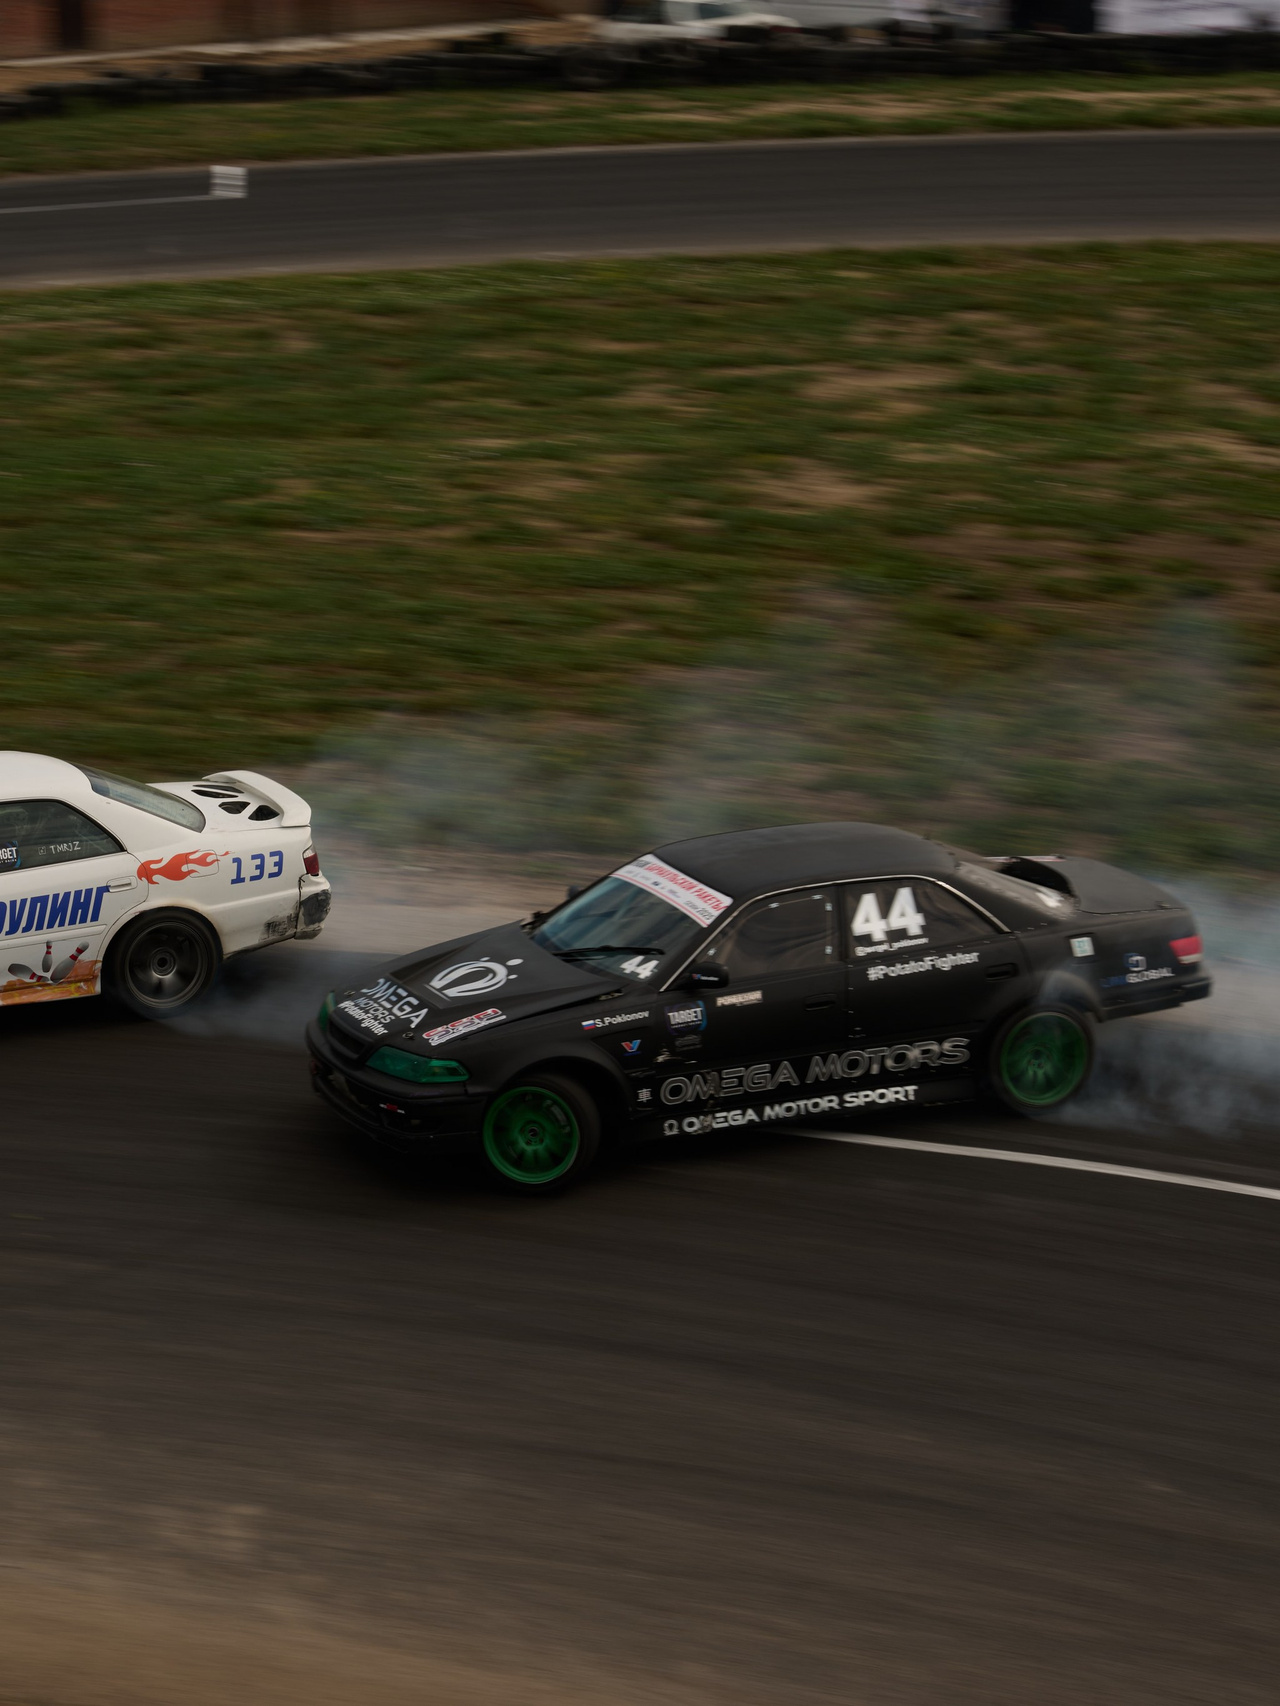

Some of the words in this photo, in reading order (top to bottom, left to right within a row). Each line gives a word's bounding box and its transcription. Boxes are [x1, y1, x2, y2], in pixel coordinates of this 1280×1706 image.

[230, 850, 284, 885] 133
[851, 886, 927, 942] 44
[619, 955, 660, 979] 44
[354, 997, 395, 1024] MOTORS
[660, 1060, 801, 1106] OMEGA
[805, 1037, 971, 1084] MOTORS
[762, 1094, 841, 1121] MOTOR
[842, 1085, 919, 1108] SPORT
